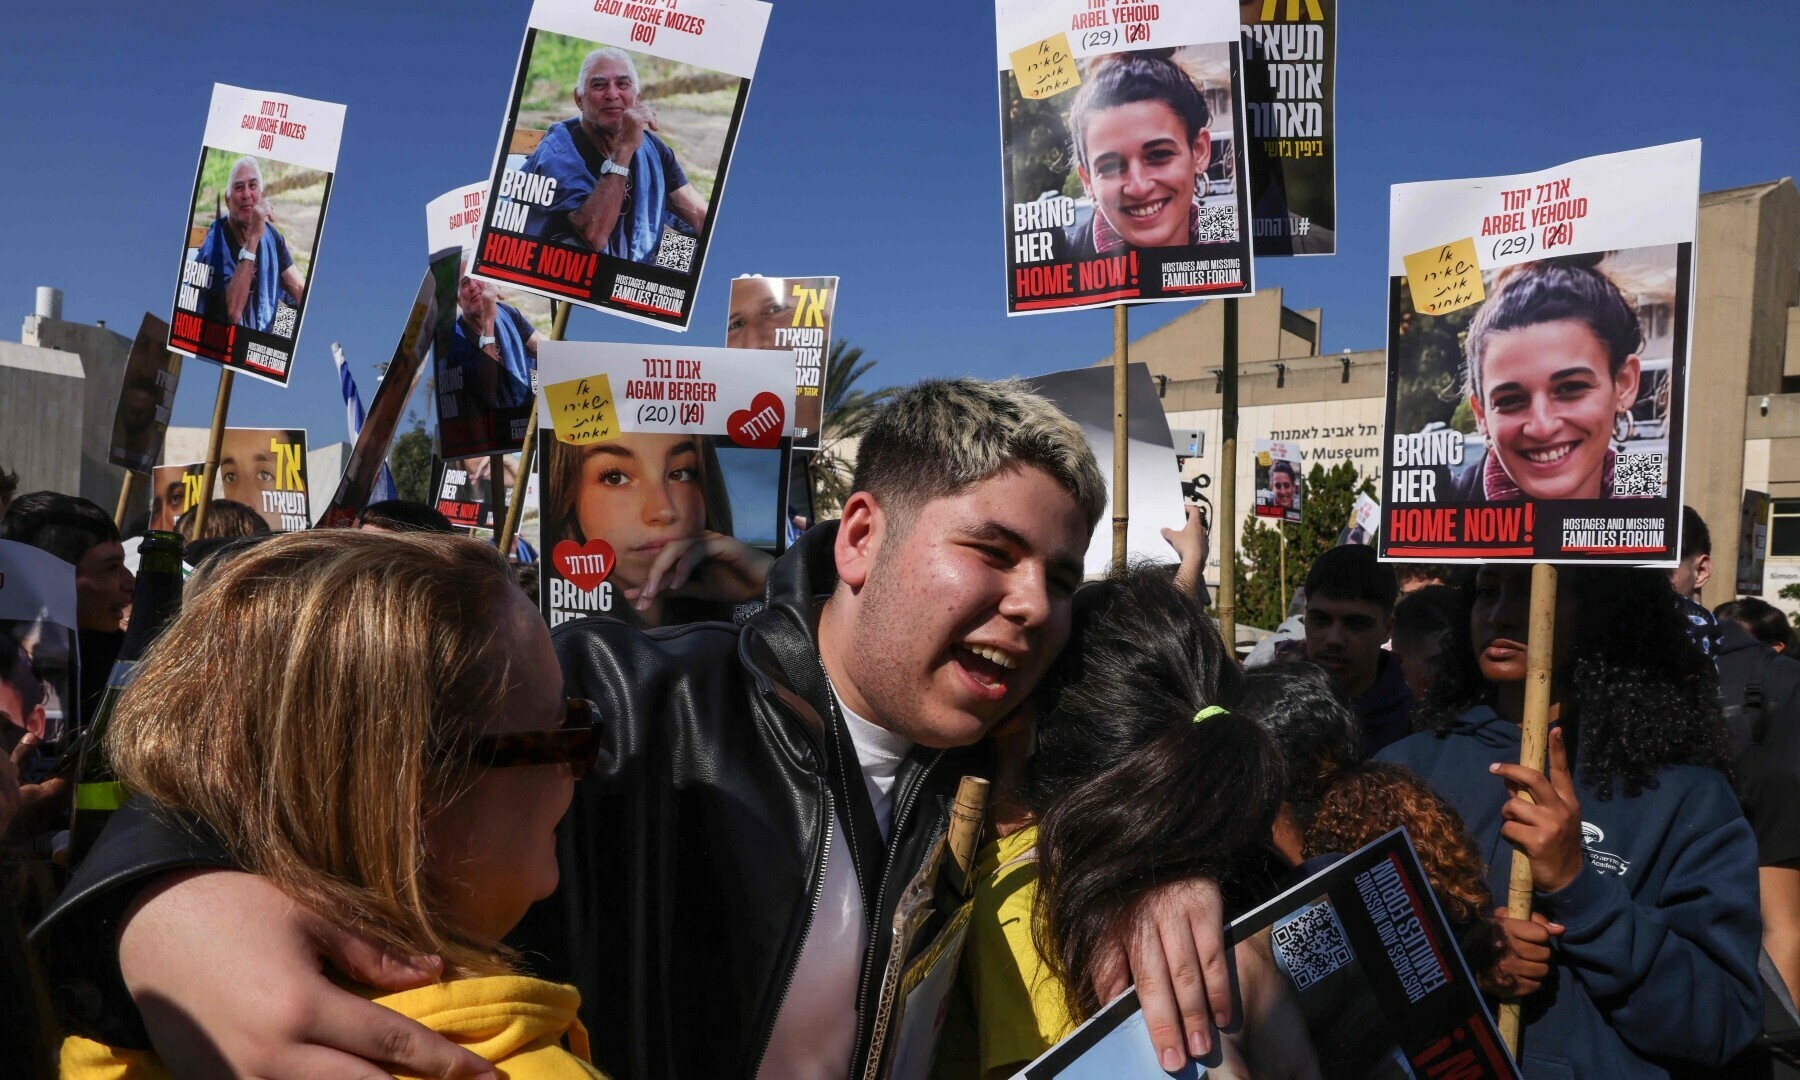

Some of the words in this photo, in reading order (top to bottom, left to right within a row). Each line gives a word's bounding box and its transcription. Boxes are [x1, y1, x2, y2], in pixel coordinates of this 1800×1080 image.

[594, 0, 621, 16] GADI
[623, 3, 664, 25] MOSHE
[664, 11, 705, 35] MOZES
[1071, 10, 1109, 31] ARBEL
[1112, 4, 1160, 24] YEHOUD
[631, 22, 656, 46] (80)
[1039, 40, 1050, 55] אל
[1082, 28, 1118, 50] (29)
[1125, 23, 1150, 43] (28)
[1240, 24, 1324, 61] תשאיר
[1033, 76, 1069, 96] מאחור
[1268, 63, 1323, 99] אותי
[241, 115, 256, 130] GADI
[255, 117, 279, 134] MOSHE
[279, 121, 307, 140] MOZES
[1247, 102, 1323, 137] מאחור
[258, 133, 274, 152] (80)
[1295, 140, 1323, 159] ביפין
[500, 168, 557, 207] BRING
[1501, 188, 1531, 212] יהוד
[1536, 178, 1571, 205] ארבל
[449, 212, 462, 231] GADI
[464, 207, 482, 226] MOS
[491, 200, 530, 234] HIM
[1014, 197, 1076, 232] BRING
[1481, 211, 1526, 237] ARBEL
[1531, 198, 1587, 228] YEHOUD
[1015, 231, 1054, 263] HER
[1439, 245, 1453, 263] אל
[1492, 233, 1535, 260] (29)
[1542, 222, 1573, 249] (28)
[483, 233, 538, 271] HOME
[537, 246, 598, 286] NOW!
[1162, 261, 1195, 273] HOSTAGES
[1195, 260, 1210, 272] AND
[1210, 258, 1240, 270] MISSING
[183, 260, 214, 289] BRING
[615, 273, 646, 292] HOSTAGES
[645, 281, 658, 293] AND
[658, 285, 686, 300] MISSING
[1016, 263, 1073, 298] HOME
[1079, 250, 1139, 292] NOW!
[1162, 270, 1204, 287] FAMILIES
[1205, 269, 1241, 285] FORUM
[178, 284, 199, 312] HIM
[611, 284, 651, 306] FAMILIES
[650, 294, 683, 314] FORUM
[791, 285, 828, 327] אל
[1429, 292, 1473, 311] מאחור
[174, 312, 203, 342] HOME
[774, 328, 824, 347] תשאירו
[246, 350, 269, 367] FAMILIES
[642, 358, 671, 379] ברגר
[676, 360, 701, 379] אגם
[439, 366, 463, 394] BRING
[576, 379, 590, 395] אל
[625, 380, 664, 400] AGAM
[669, 381, 717, 402] BERGER
[637, 404, 676, 425] (20)
[569, 427, 609, 441] מאחור
[1270, 426, 1318, 440] לאמנות
[1322, 426, 1354, 438] אביב
[1358, 423, 1377, 436] תל
[1312, 447, 1379, 460] Museum
[1393, 431, 1464, 467] BRING
[270, 437, 304, 492] אל
[445, 469, 467, 485] BRING
[441, 483, 457, 500] HER
[1392, 470, 1436, 503] HER
[262, 490, 306, 515] תשאירו
[438, 500, 459, 517] HOME
[460, 502, 480, 520] NOW!
[1390, 508, 1457, 542] HOME
[1464, 502, 1535, 543] NOW!
[1563, 518, 1606, 530] HOSTAGES
[1606, 518, 1625, 530] AND
[1625, 517, 1665, 530] MISSING
[1562, 531, 1617, 548] FAMILIES
[1619, 530, 1664, 548] FORUM
[565, 554, 605, 575] חזרתי
[550, 578, 613, 612] BRING
[1354, 871, 1388, 924] MISSING
[1370, 858, 1414, 922] FORUM
[1377, 920, 1396, 950] AND
[1399, 915, 1448, 994] FAMILIES
[1387, 947, 1426, 1004] HOSTAGES
